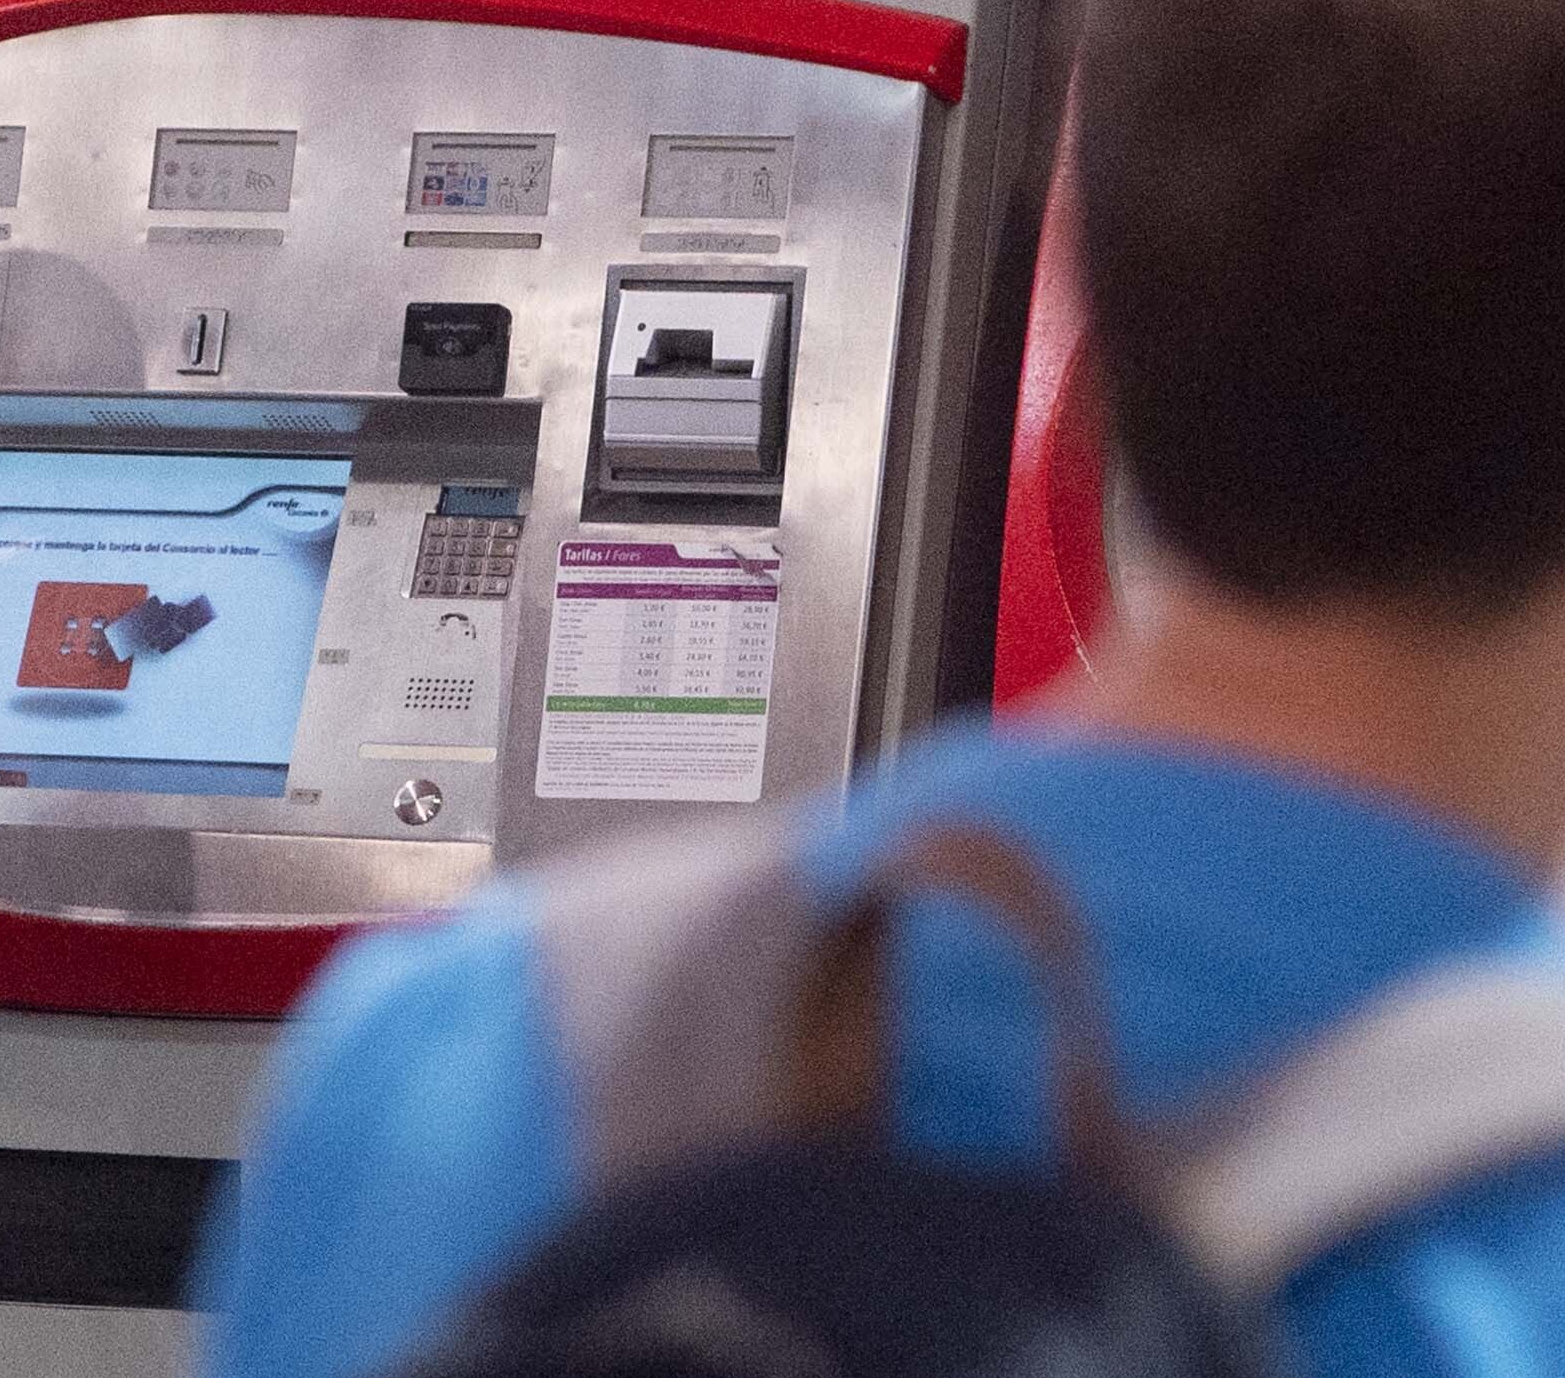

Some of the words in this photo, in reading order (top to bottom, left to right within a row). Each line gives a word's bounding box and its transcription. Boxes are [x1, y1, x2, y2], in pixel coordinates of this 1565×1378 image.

[44, 539, 94, 552] mantenga
[145, 541, 161, 553] del
[565, 548, 602, 561] Tarifas
[612, 549, 641, 562] Fares
